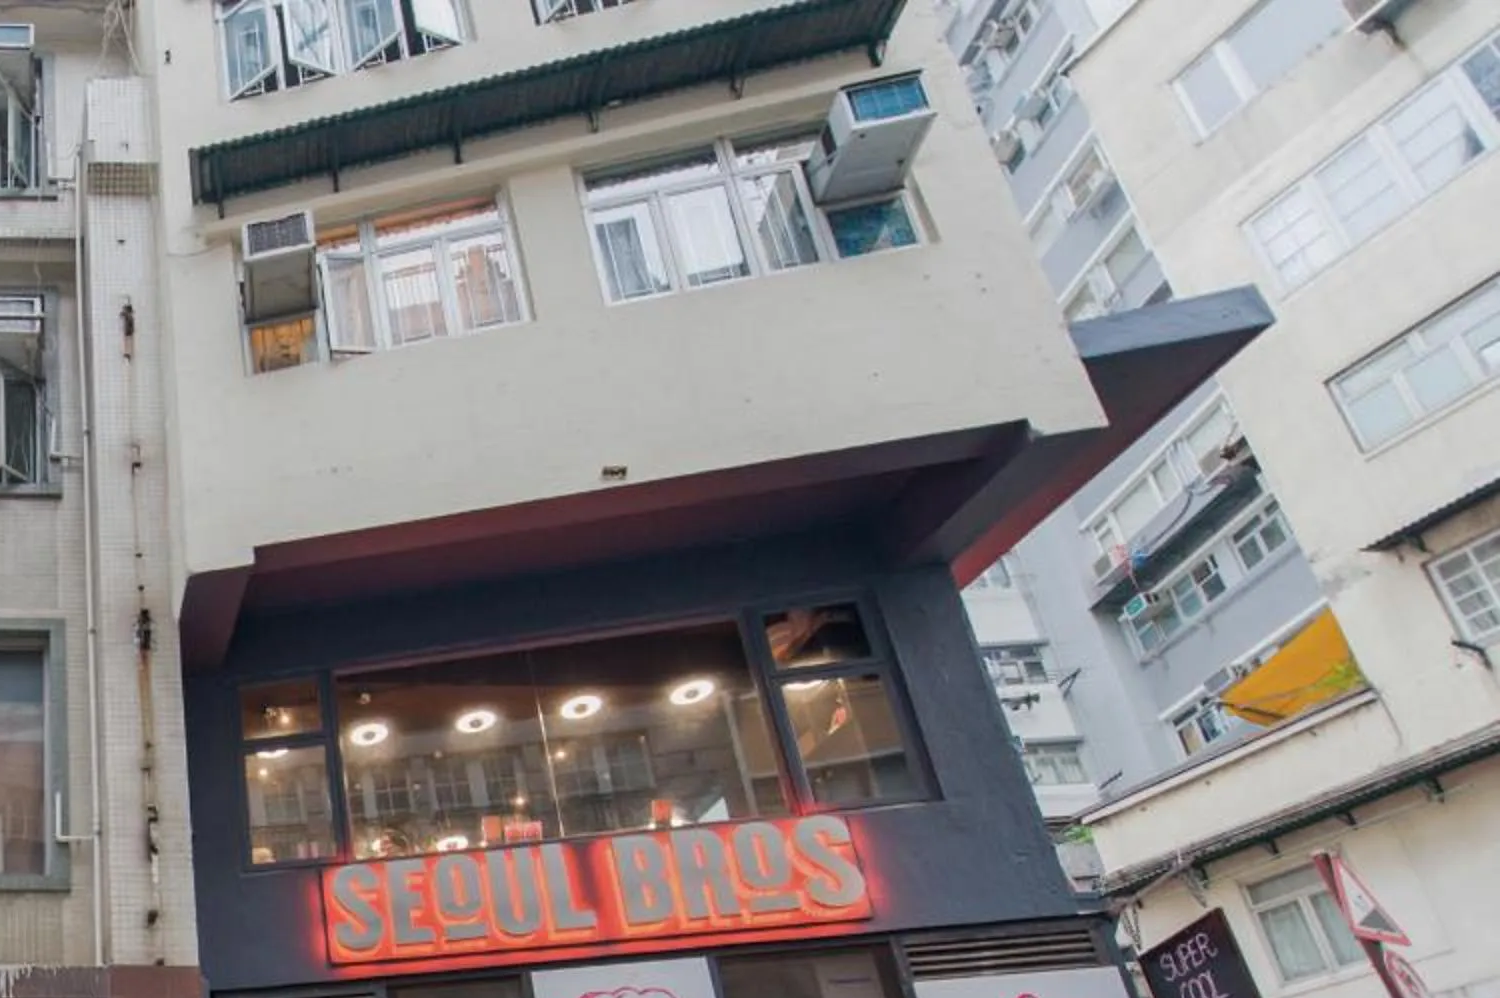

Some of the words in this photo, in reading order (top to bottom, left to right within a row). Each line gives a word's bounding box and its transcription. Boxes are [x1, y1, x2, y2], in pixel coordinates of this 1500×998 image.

[330, 844, 597, 950] SEOUL
[612, 815, 867, 925] BROS
[1160, 933, 1218, 981] SUPER
